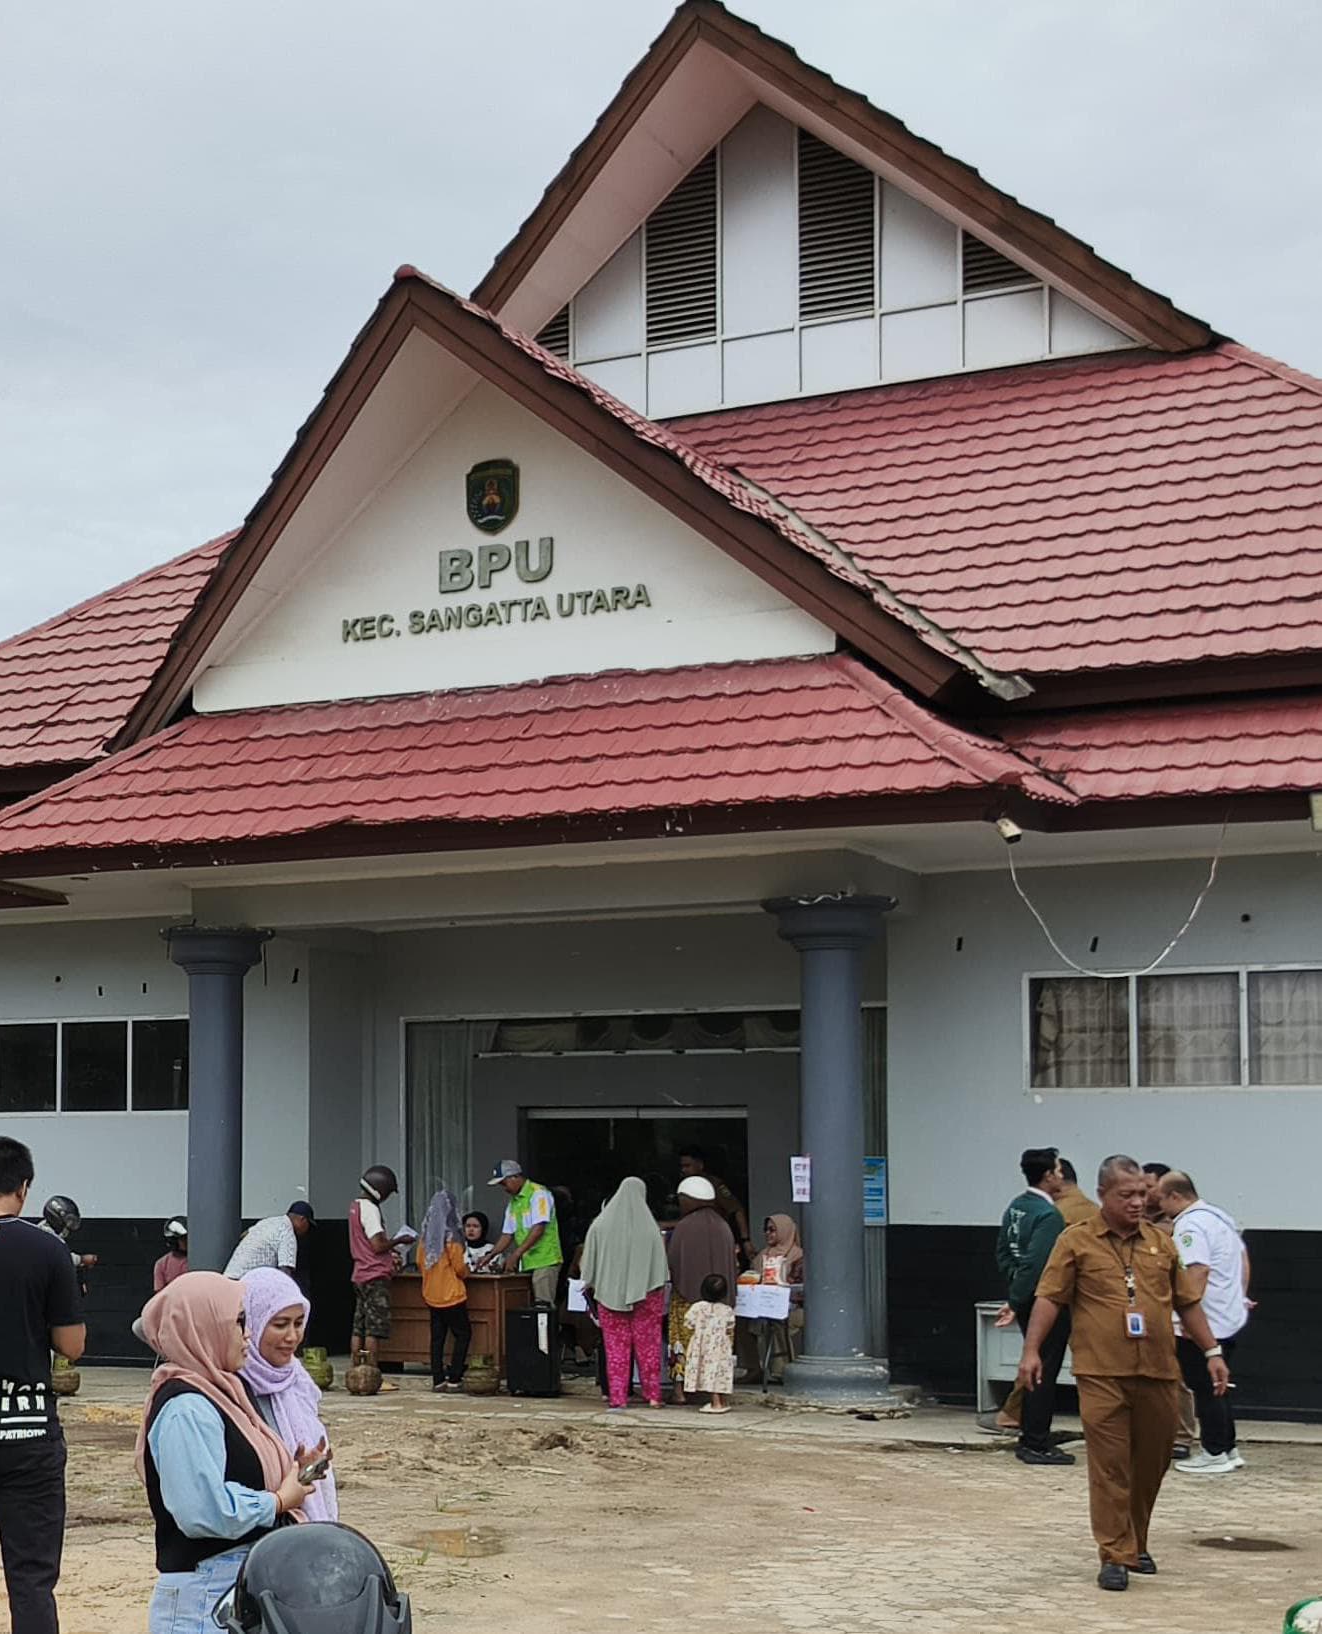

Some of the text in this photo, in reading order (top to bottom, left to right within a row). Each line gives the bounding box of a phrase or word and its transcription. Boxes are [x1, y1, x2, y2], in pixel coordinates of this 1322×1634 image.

[439, 537, 554, 594] BPU
[341, 583, 652, 642] KEC. SANGATTA UTARA
